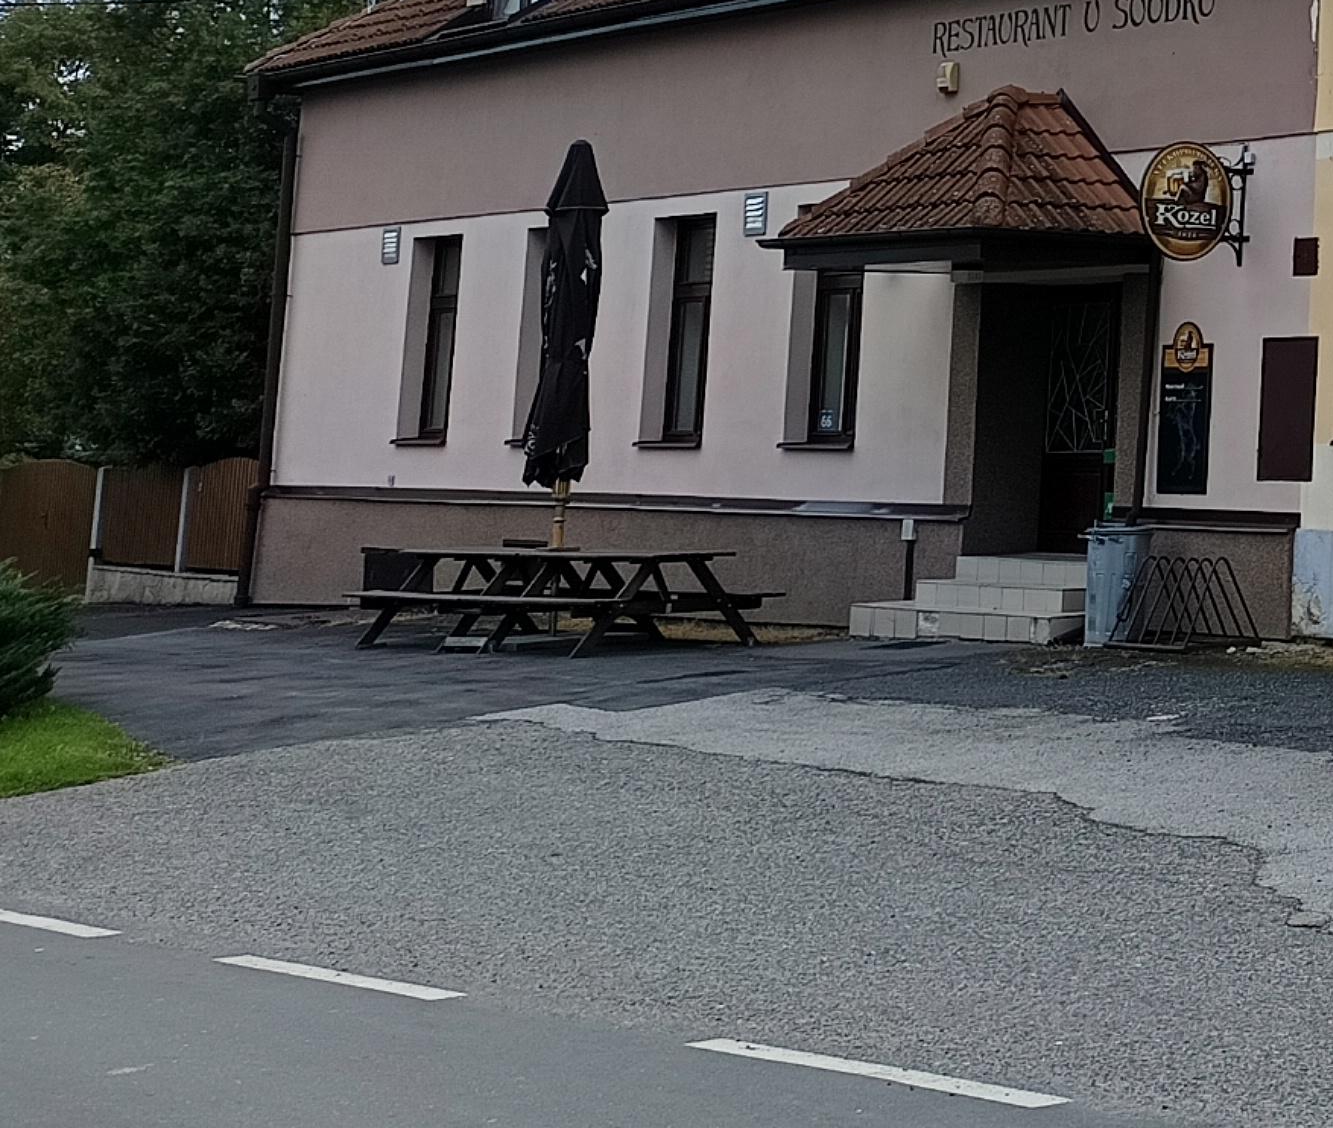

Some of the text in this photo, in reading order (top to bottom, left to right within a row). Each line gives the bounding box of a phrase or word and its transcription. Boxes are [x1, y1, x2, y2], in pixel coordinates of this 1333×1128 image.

[932, 3, 1073, 58] RESTAURANT
[1083, 1, 1101, 33] U
[1154, 203, 1217, 229] Kozel
